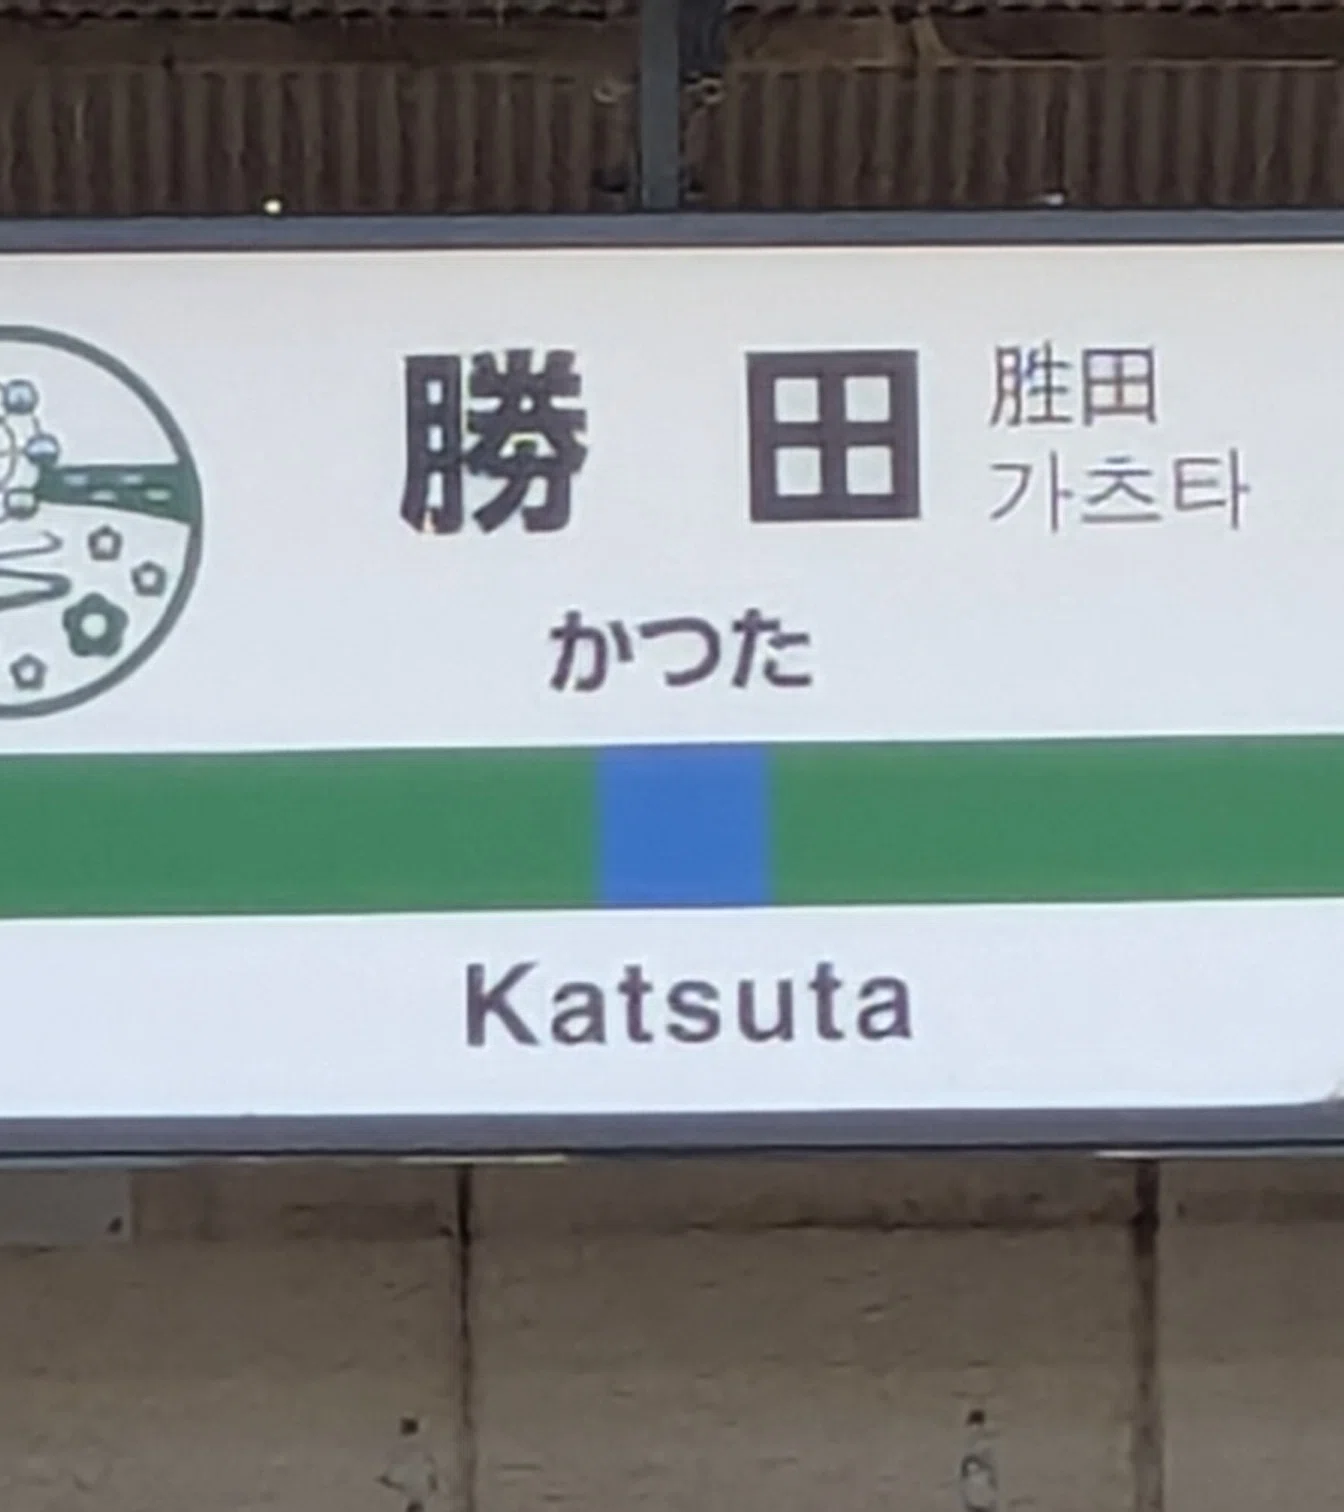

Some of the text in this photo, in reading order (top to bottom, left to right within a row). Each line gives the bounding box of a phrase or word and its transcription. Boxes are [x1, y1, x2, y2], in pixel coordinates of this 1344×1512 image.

[988, 340, 1159, 429] 胜田
[399, 348, 921, 536] 勝田
[988, 447, 1251, 533] 가츠타
[548, 606, 814, 692] かつた
[465, 960, 913, 1047] Katsuta
